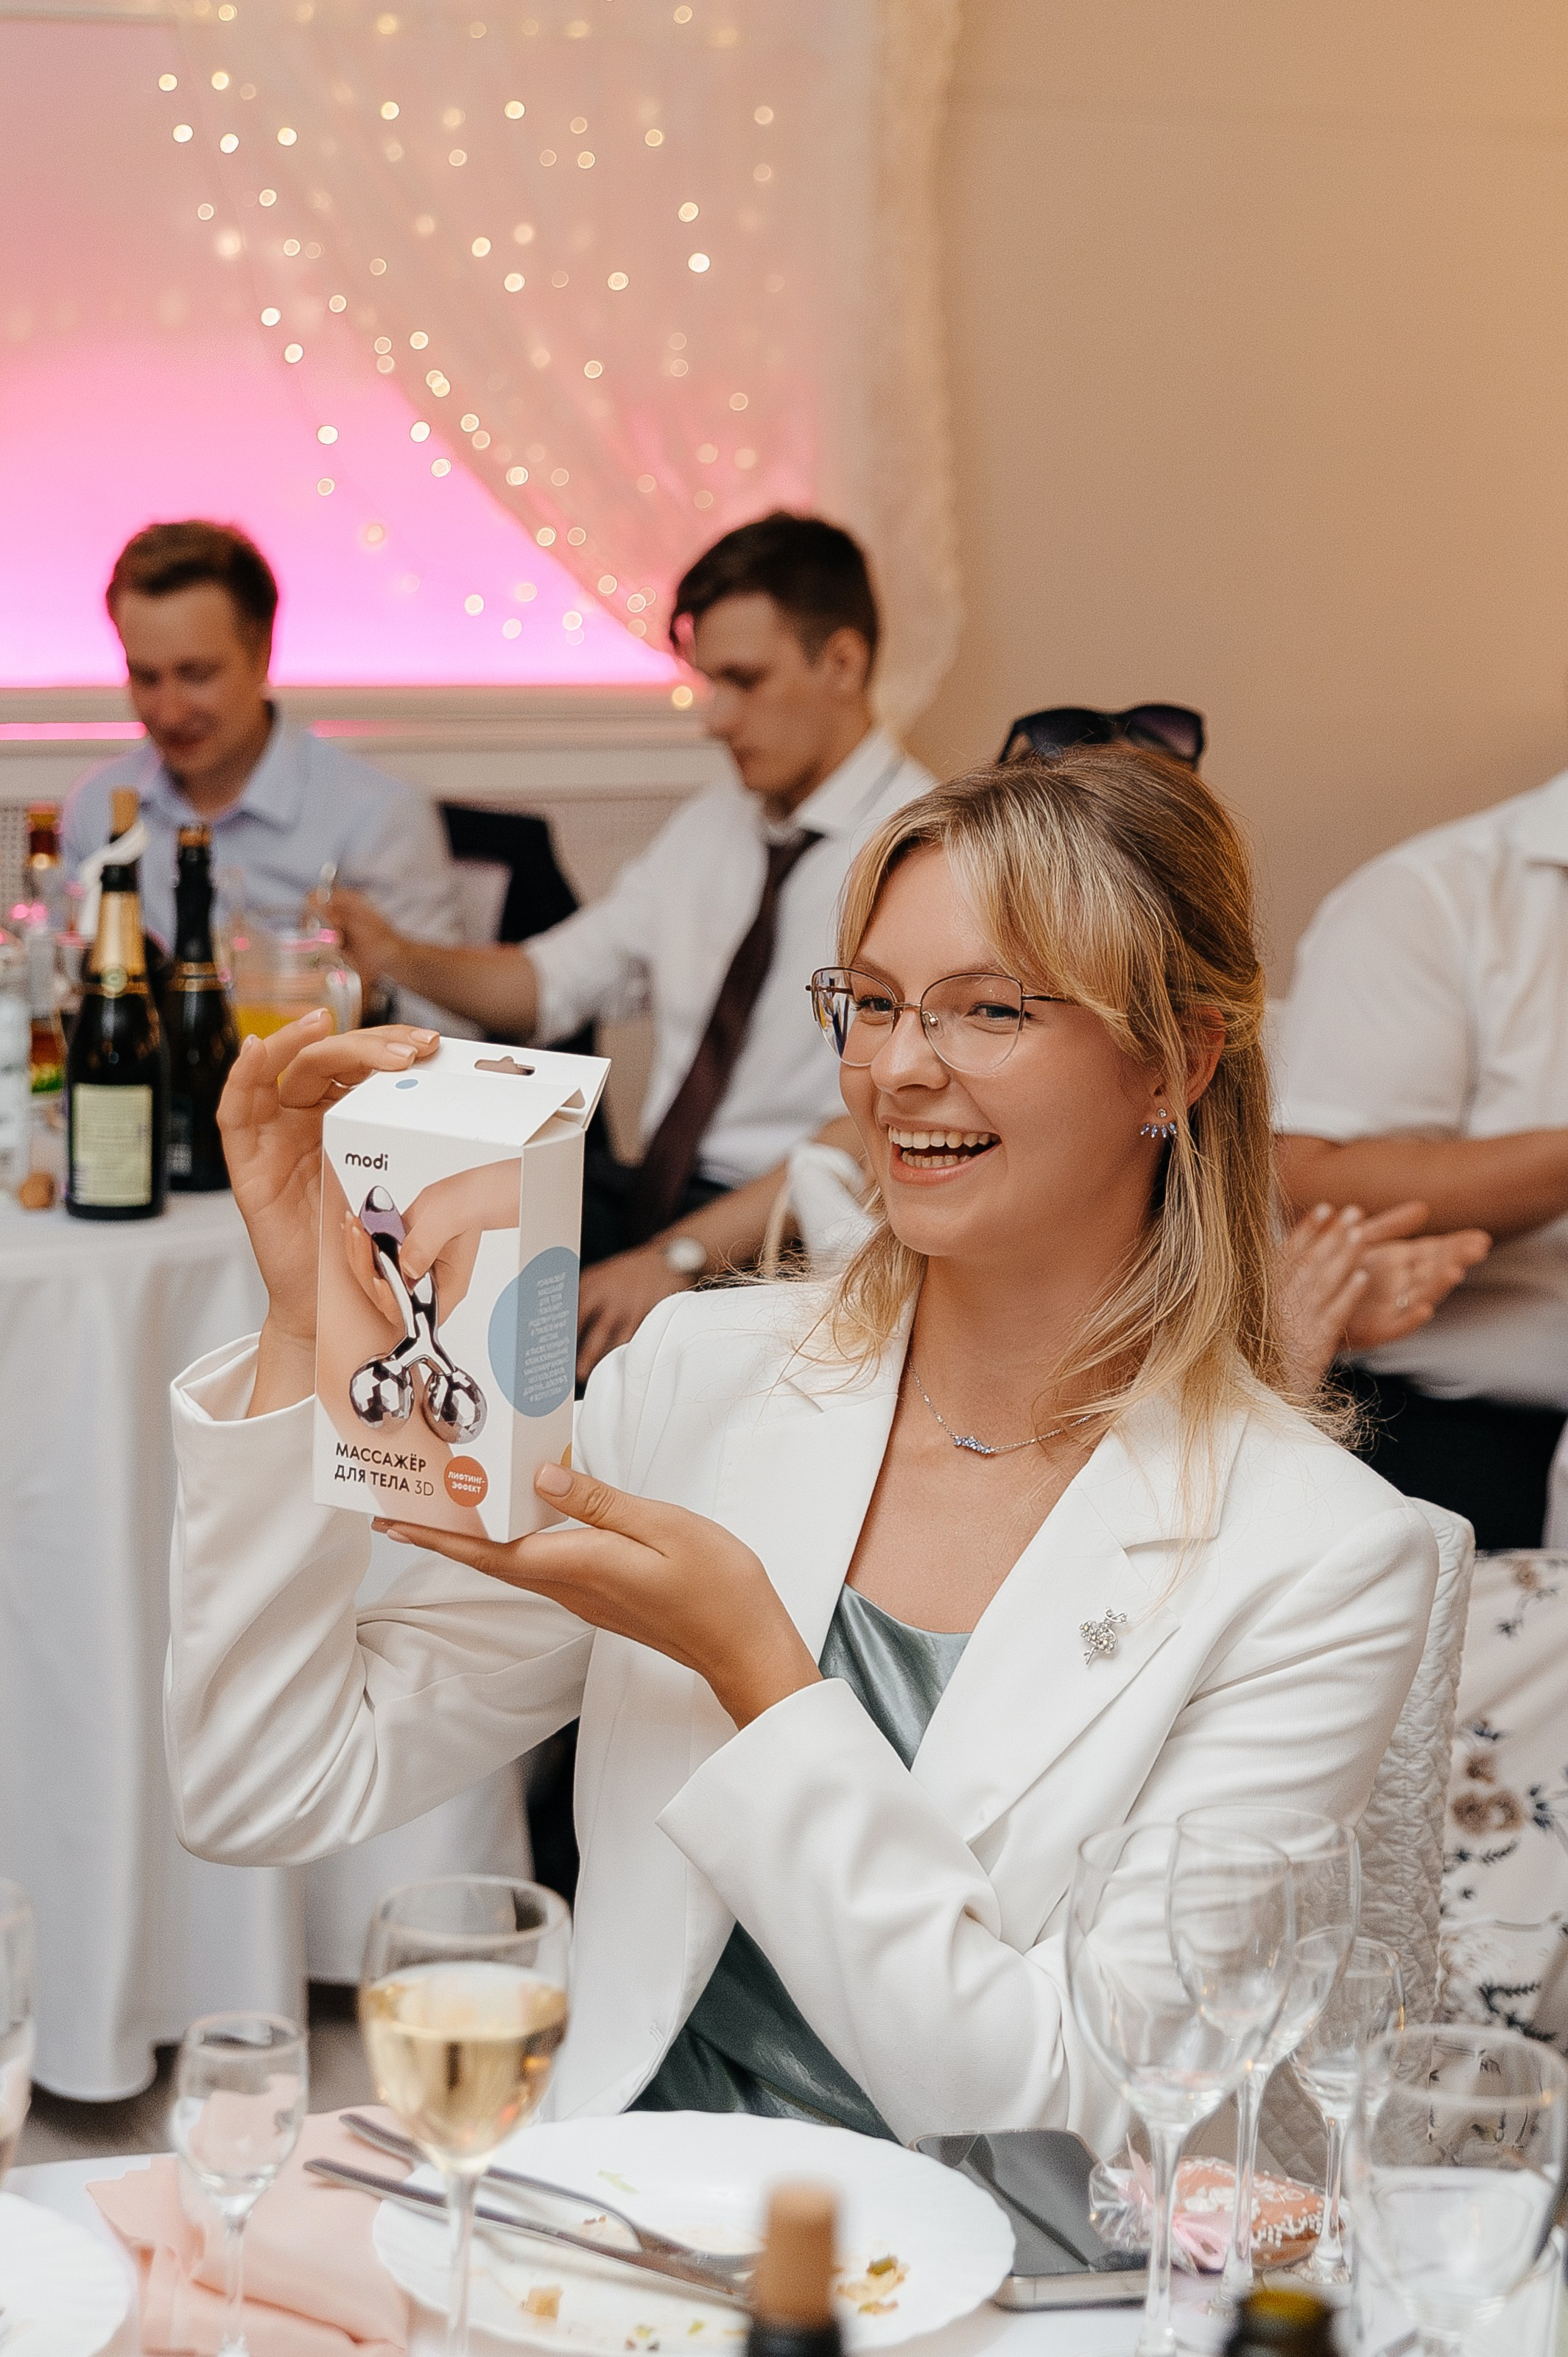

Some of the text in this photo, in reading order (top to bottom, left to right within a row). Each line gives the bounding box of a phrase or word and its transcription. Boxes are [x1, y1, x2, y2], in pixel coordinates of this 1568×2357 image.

[345, 1153, 388, 1171] modi
[336, 1442, 426, 1472] МАССАЖЁР
[334, 1464, 435, 1496] ДЛЯ ТЕЛА 3D
[448, 1471, 485, 1483] ЛИФТИНГ-
[451, 1482, 482, 1494] ЭФФЕКТ
